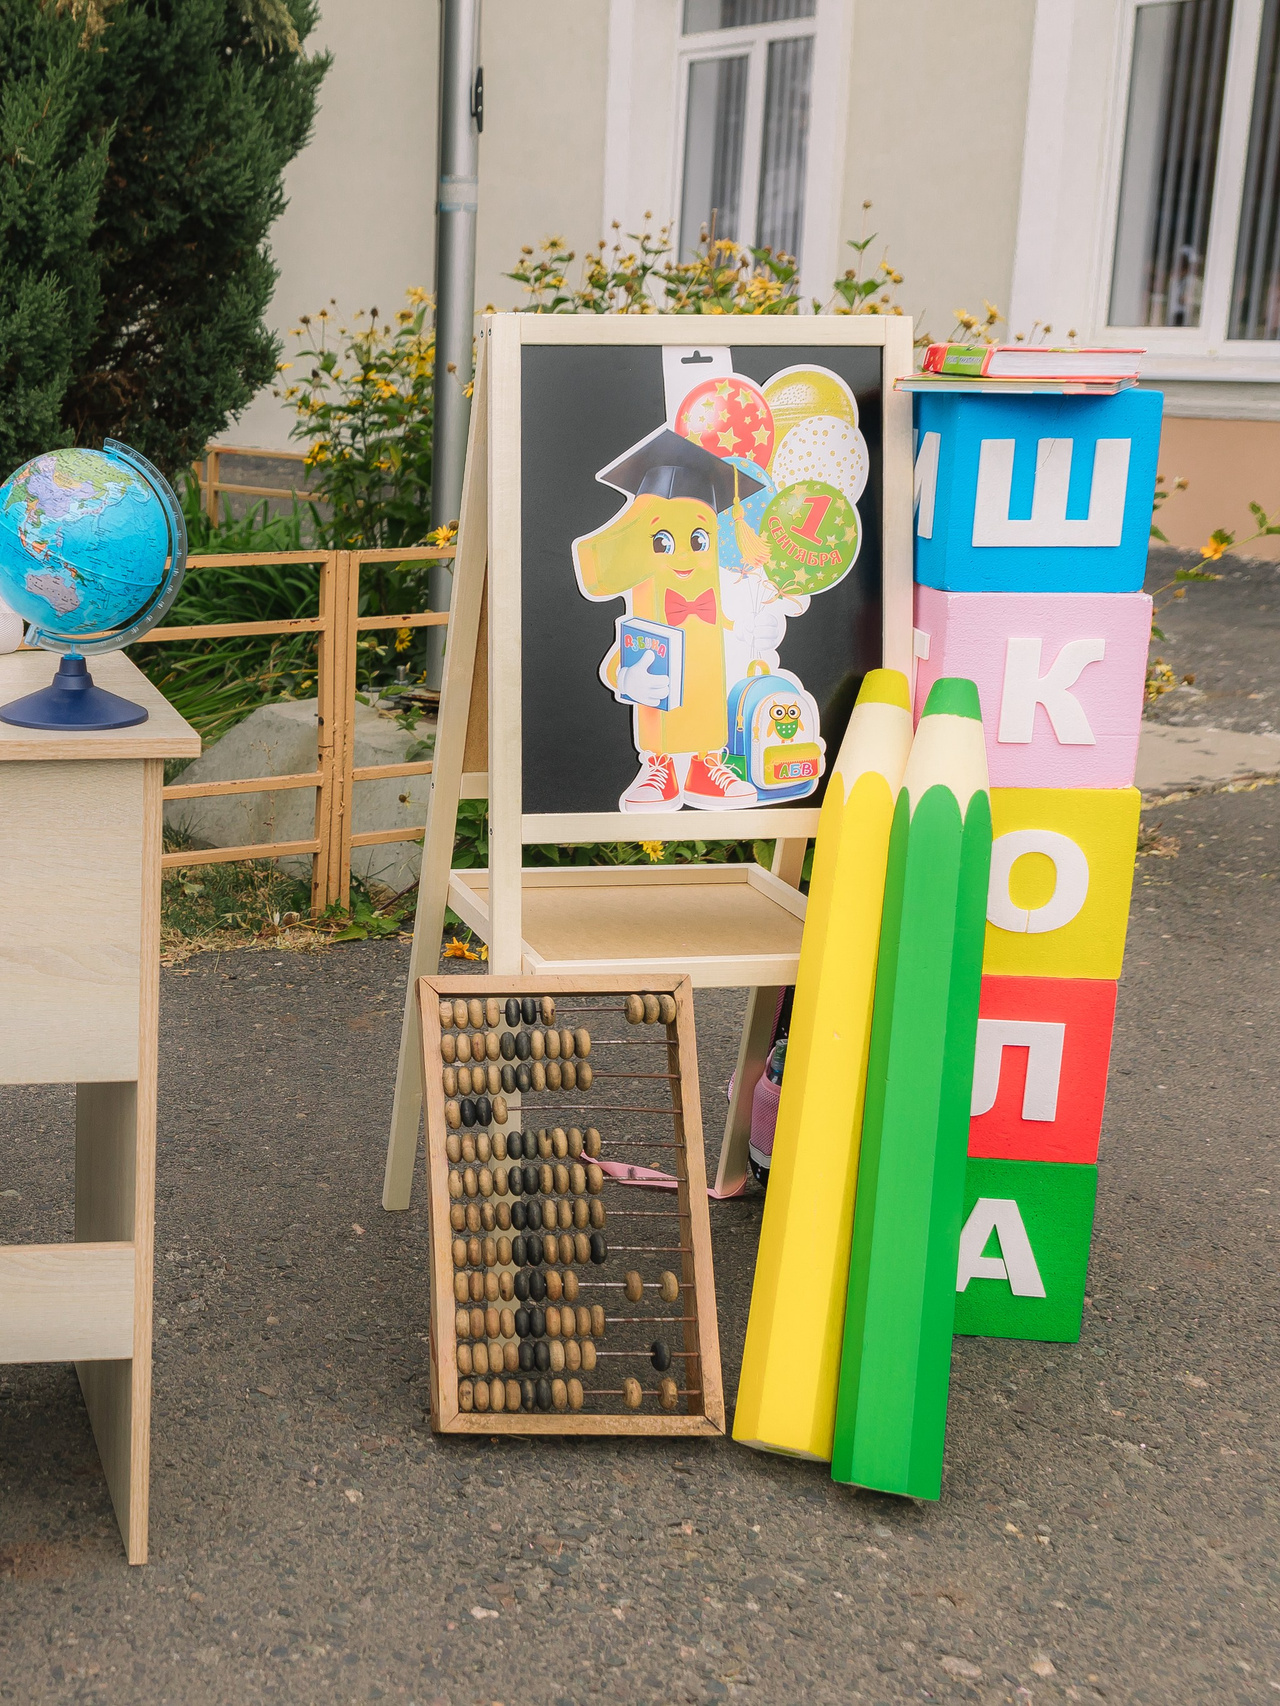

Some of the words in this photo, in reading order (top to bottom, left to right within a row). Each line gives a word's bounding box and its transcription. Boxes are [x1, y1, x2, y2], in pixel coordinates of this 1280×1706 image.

[790, 494, 833, 546] 1
[768, 515, 843, 567] СЕНТЯБРЯ
[624, 634, 666, 658] АЗБУКА
[778, 762, 813, 778] АБВ
